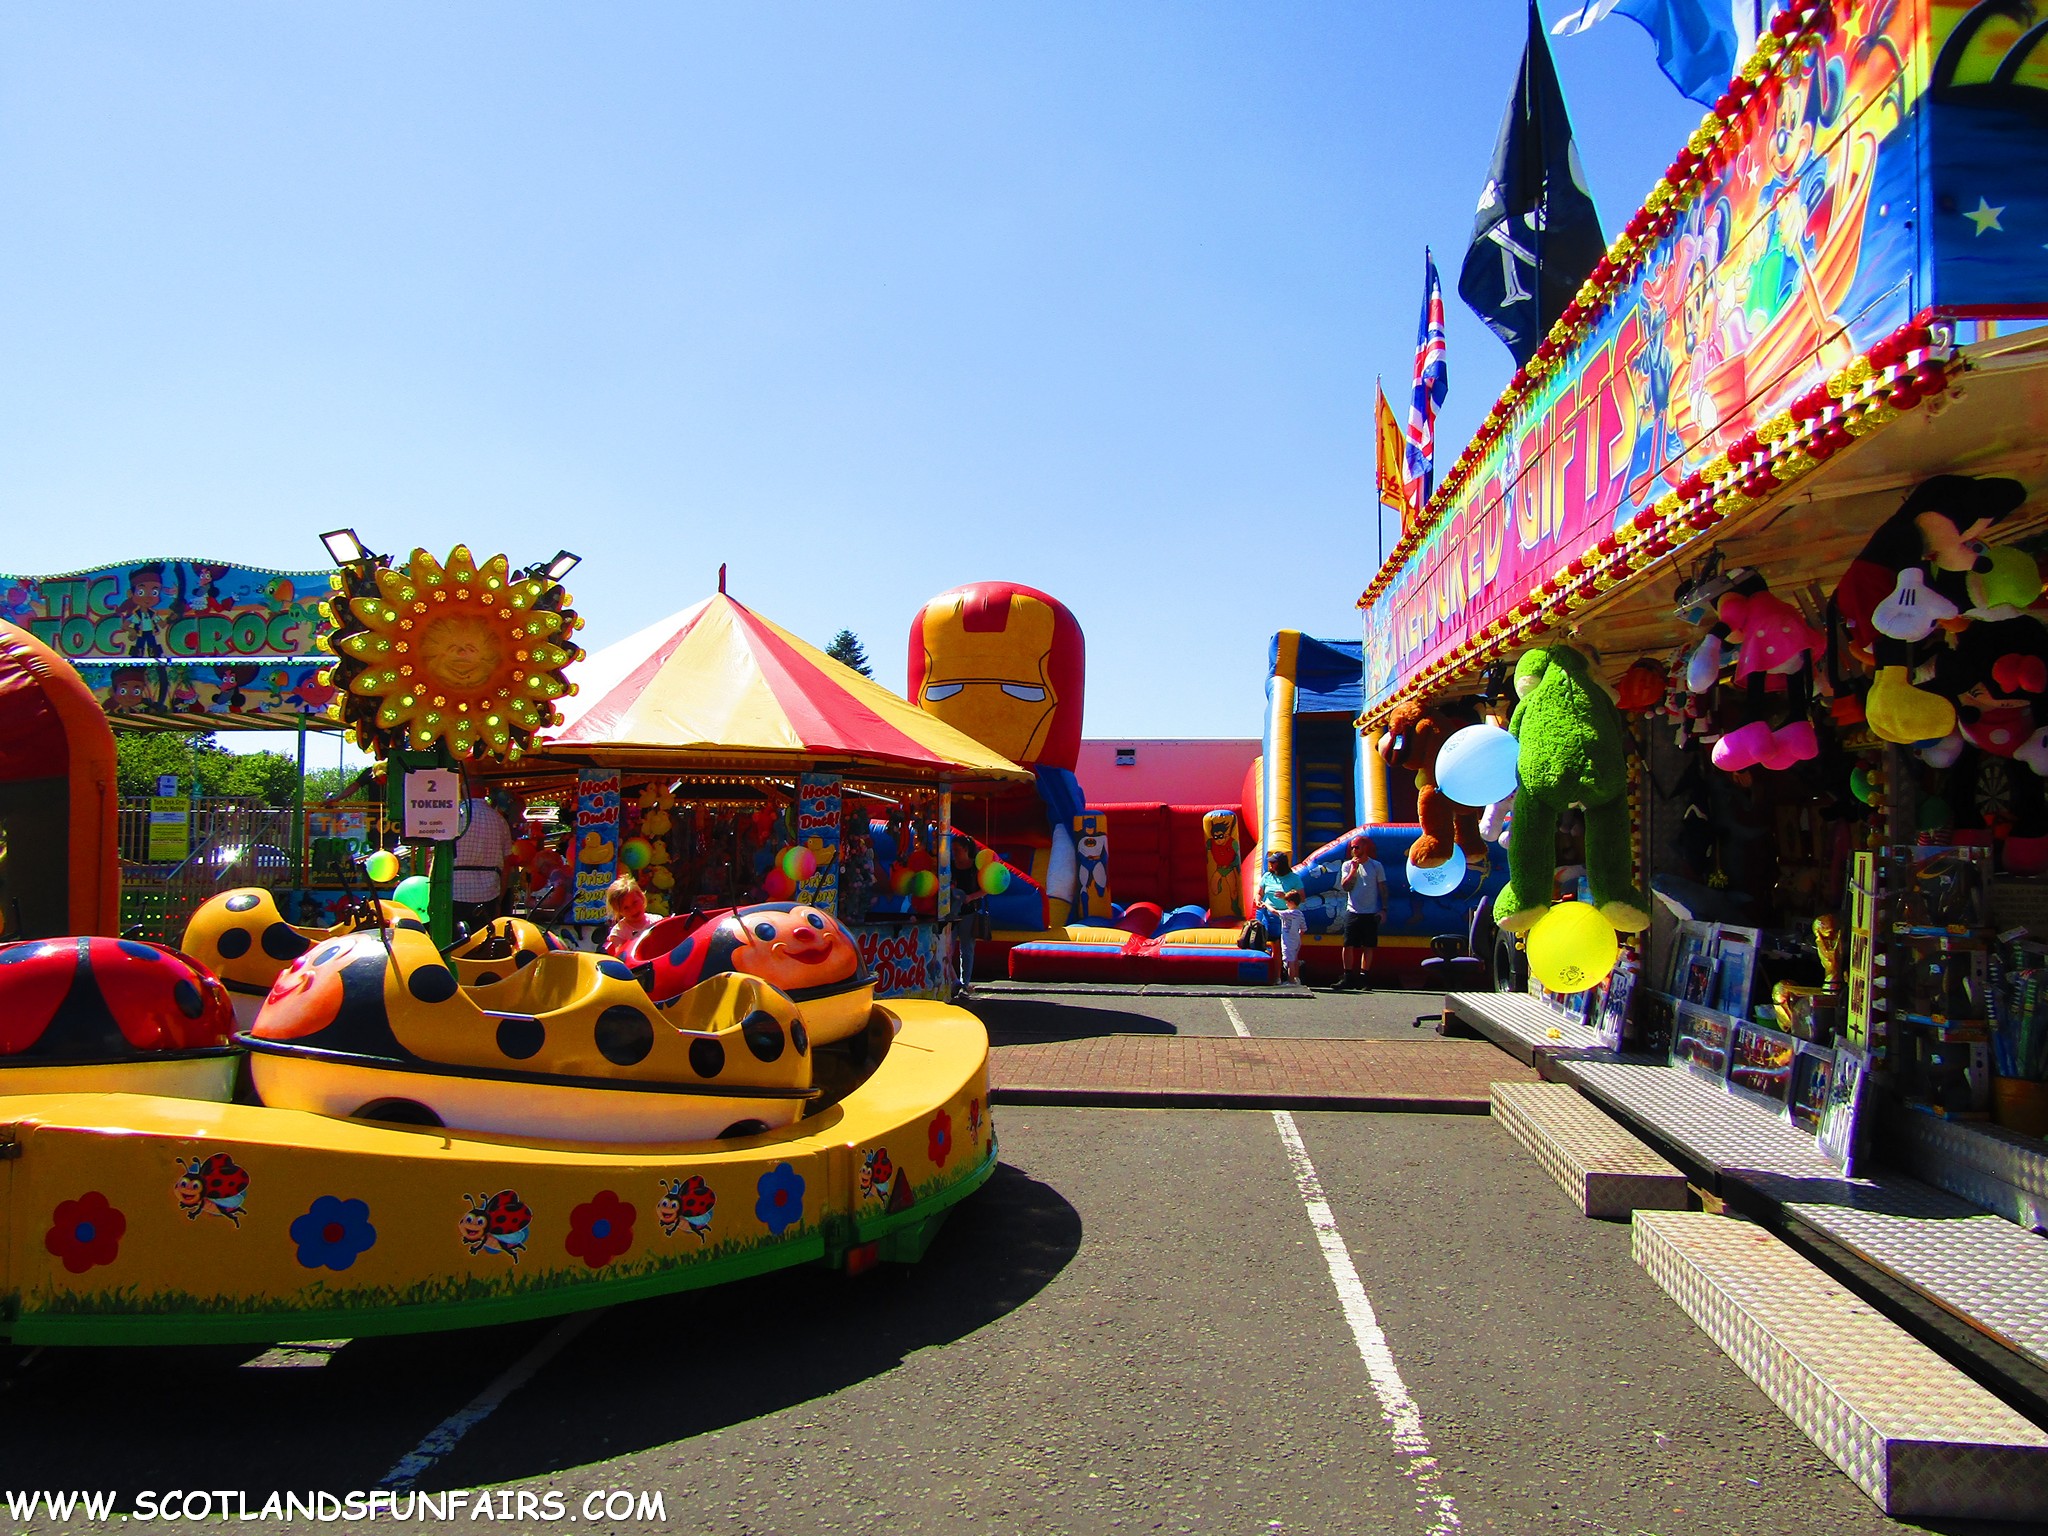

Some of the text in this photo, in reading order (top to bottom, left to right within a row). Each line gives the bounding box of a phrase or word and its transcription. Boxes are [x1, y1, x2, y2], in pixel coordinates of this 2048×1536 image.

[1515, 303, 1641, 550] GIFTS
[39, 576, 118, 617] TIC
[29, 612, 301, 656] TOC CROC
[427, 780, 437, 792] 2
[580, 776, 620, 797] Hook
[802, 782, 841, 800] Hook
[411, 800, 453, 809] TOKENS
[592, 795, 604, 808] a
[814, 799, 826, 812] a
[577, 806, 619, 827] Duck!
[800, 811, 840, 830] Duck!
[576, 869, 613, 888] Prize
[574, 889, 607, 904] Ever
[857, 927, 919, 967] Hook
[873, 956, 927, 995] Duck
